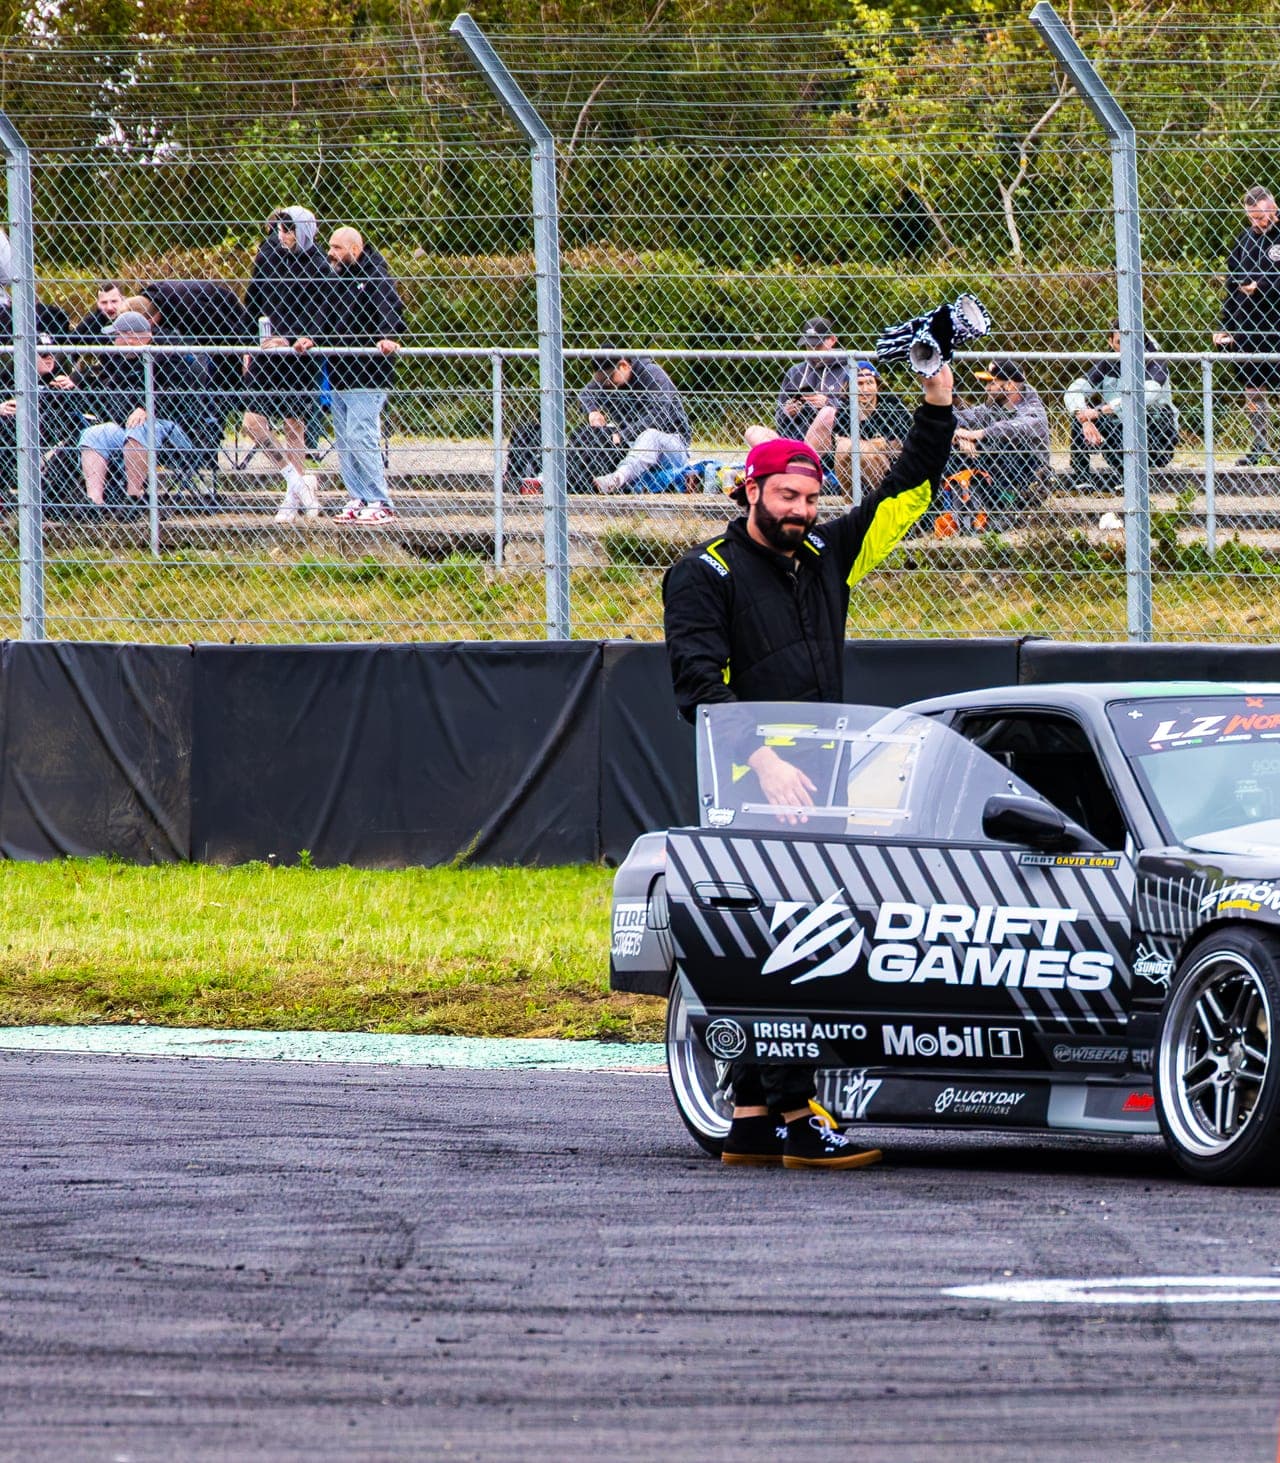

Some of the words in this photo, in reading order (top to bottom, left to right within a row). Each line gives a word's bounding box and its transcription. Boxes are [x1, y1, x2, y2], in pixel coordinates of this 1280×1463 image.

[1148, 715, 1227, 743] LZ
[1055, 856, 1087, 866] DAVID
[1088, 857, 1116, 867] EGAN
[873, 901, 1079, 947] DRIFT
[867, 943, 1115, 991] GAMES
[753, 1022, 807, 1040] IRISH
[811, 1023, 868, 1041] AUTO
[881, 1024, 983, 1057] Mobil
[755, 1042, 821, 1058] PARTS
[953, 1104, 1012, 1116] COMPETITIONS
